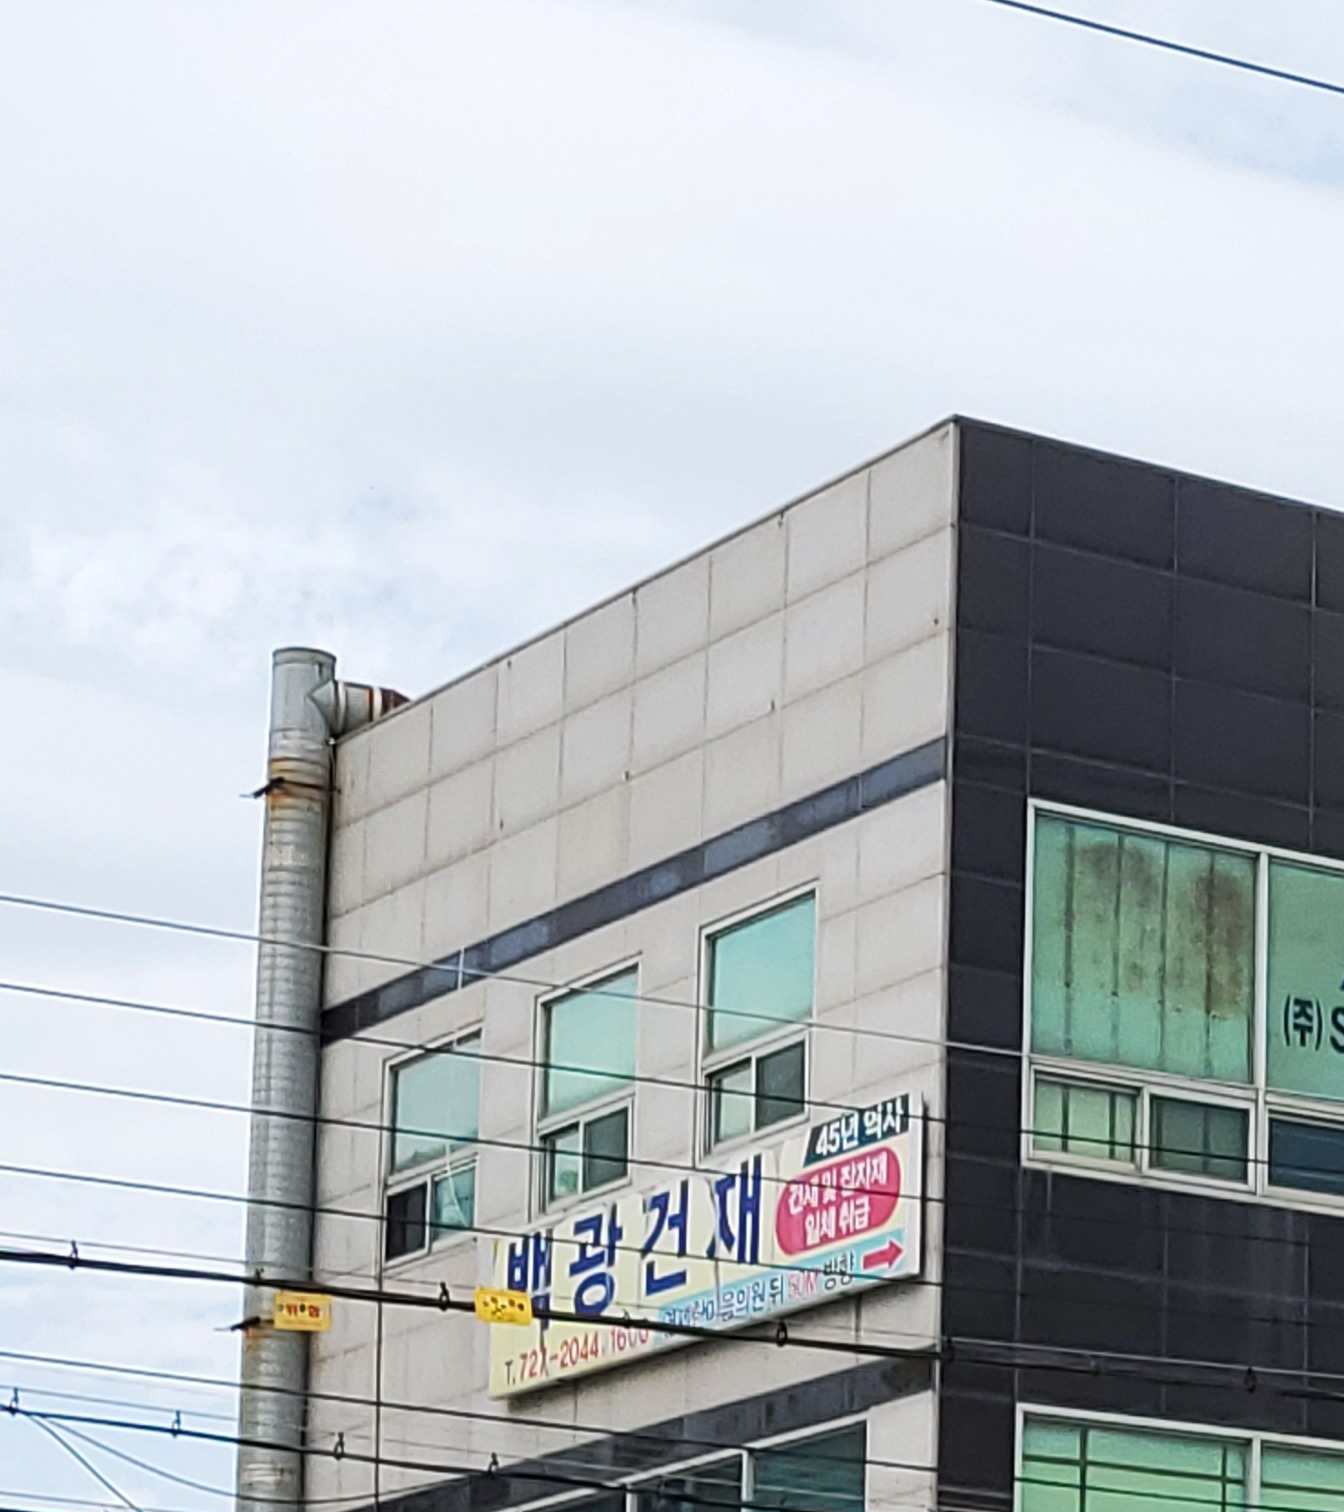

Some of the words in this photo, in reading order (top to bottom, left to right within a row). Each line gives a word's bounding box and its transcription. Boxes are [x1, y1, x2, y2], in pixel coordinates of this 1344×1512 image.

[815, 1111, 859, 1156] 45년
[839, 1196, 871, 1236] 취급
[508, 1154, 763, 1329] 백광건재
